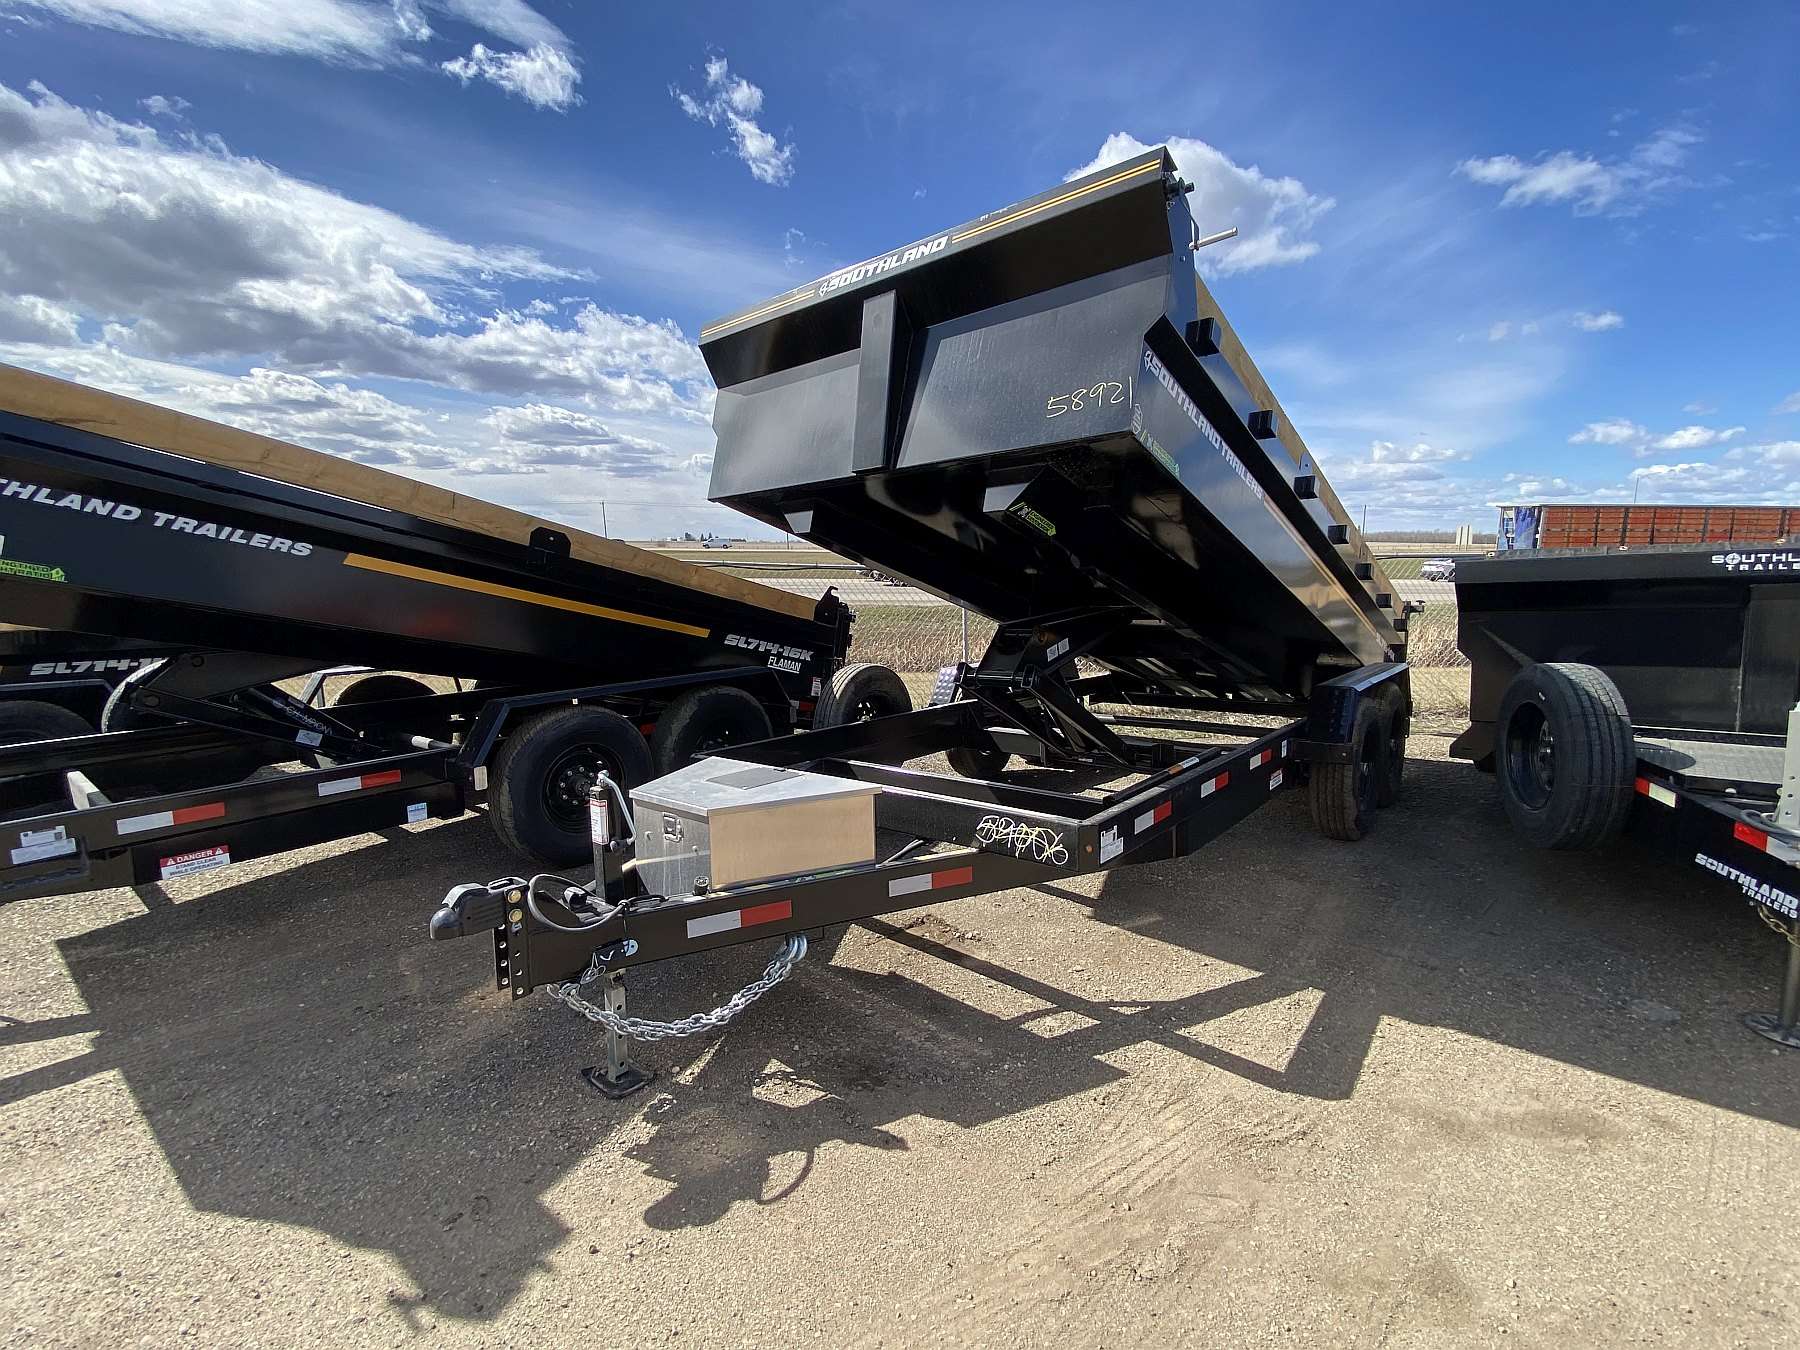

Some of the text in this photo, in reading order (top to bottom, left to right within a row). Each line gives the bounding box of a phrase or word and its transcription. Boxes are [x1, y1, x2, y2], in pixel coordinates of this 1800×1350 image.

[827, 236, 949, 292] SOUTHLAND
[1046, 376, 1132, 418] 58921
[1150, 356, 1221, 450] SOUTHLAND
[1219, 437, 1264, 500] TRAILERS
[152, 511, 313, 557] TRAILERS
[723, 634, 814, 661] SL714-16K
[767, 655, 802, 672] FLAMAN
[176, 850, 214, 863] DANGER
[1694, 853, 1799, 910] SOUTHLAND
[1742, 885, 1798, 918] TRAILERS
